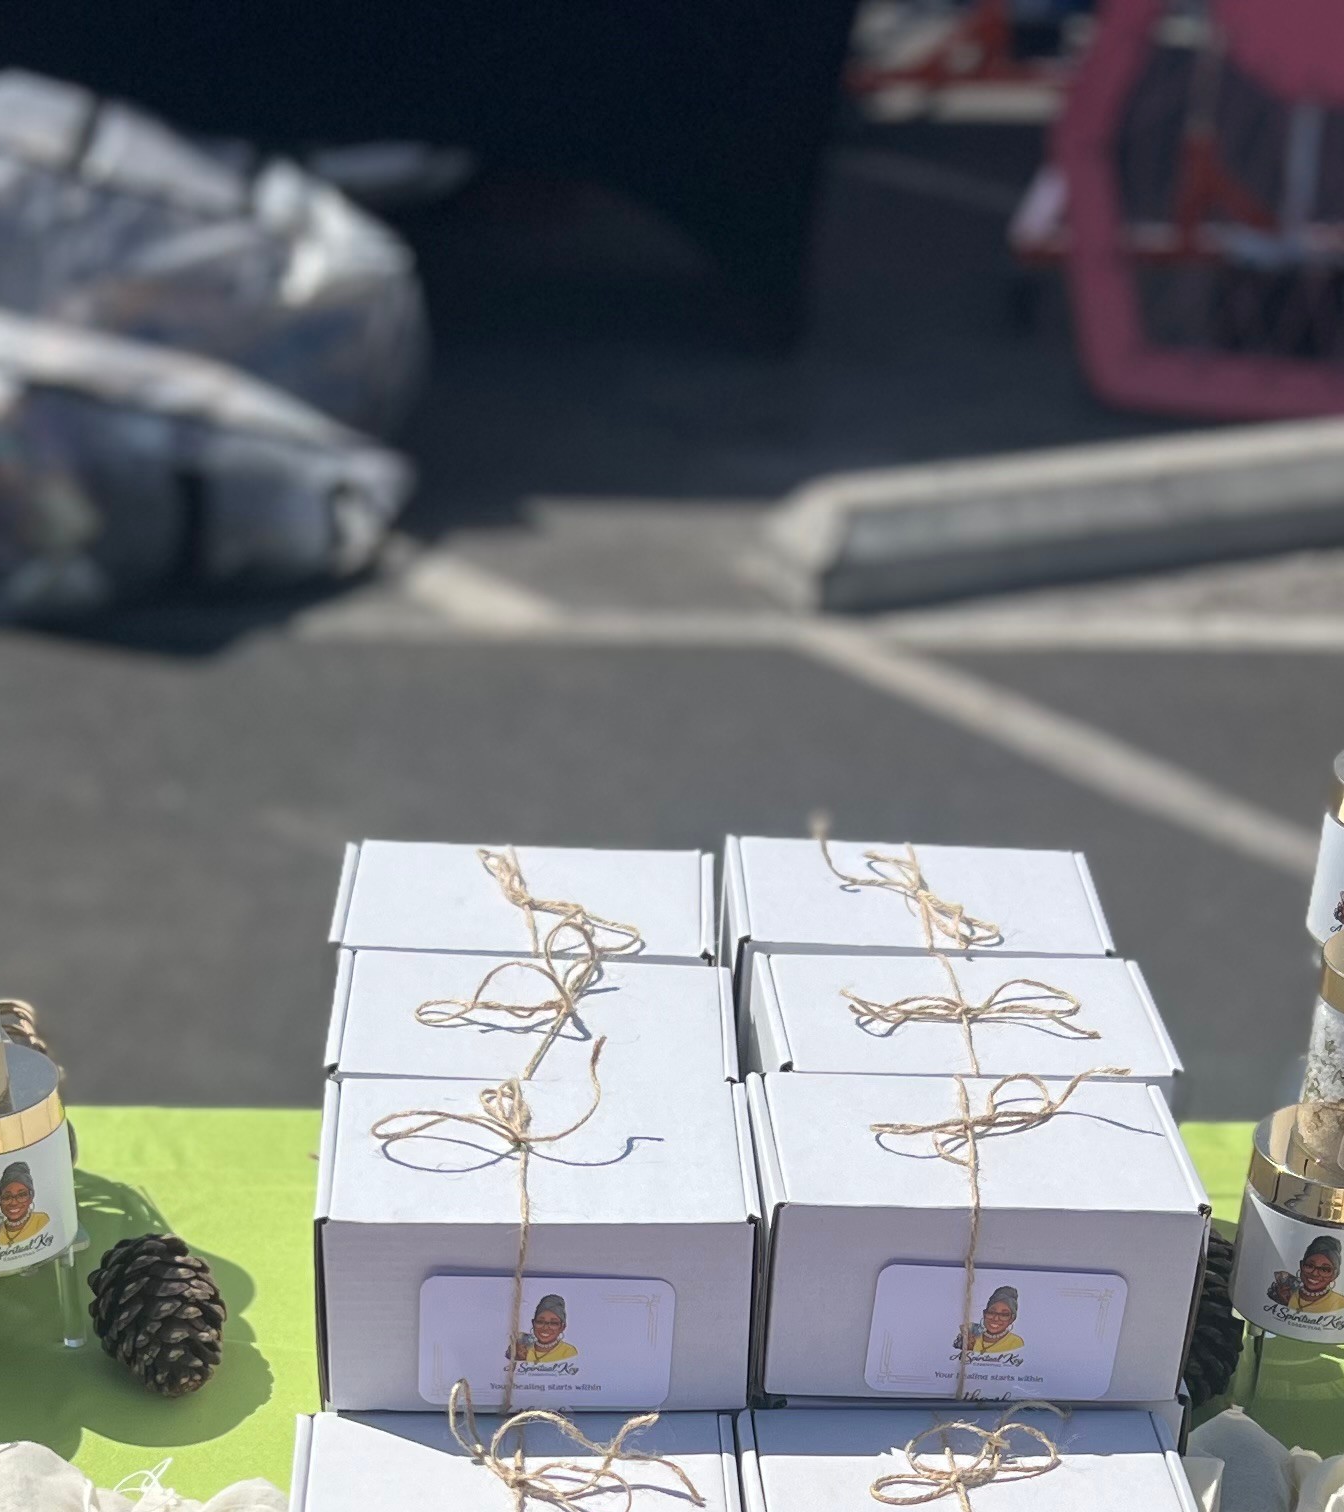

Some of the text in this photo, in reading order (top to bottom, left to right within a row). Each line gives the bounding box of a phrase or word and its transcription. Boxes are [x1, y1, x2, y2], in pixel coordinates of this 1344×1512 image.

[33, 1232, 54, 1250] Key
[1263, 1303, 1279, 1316] A
[1276, 1306, 1324, 1326] Spiritual
[517, 1362, 556, 1375] Spiritual
[556, 1361, 579, 1376] Key
[935, 1371, 955, 1379] Your
[548, 1383, 573, 1391] starts
[576, 1383, 602, 1392] within
